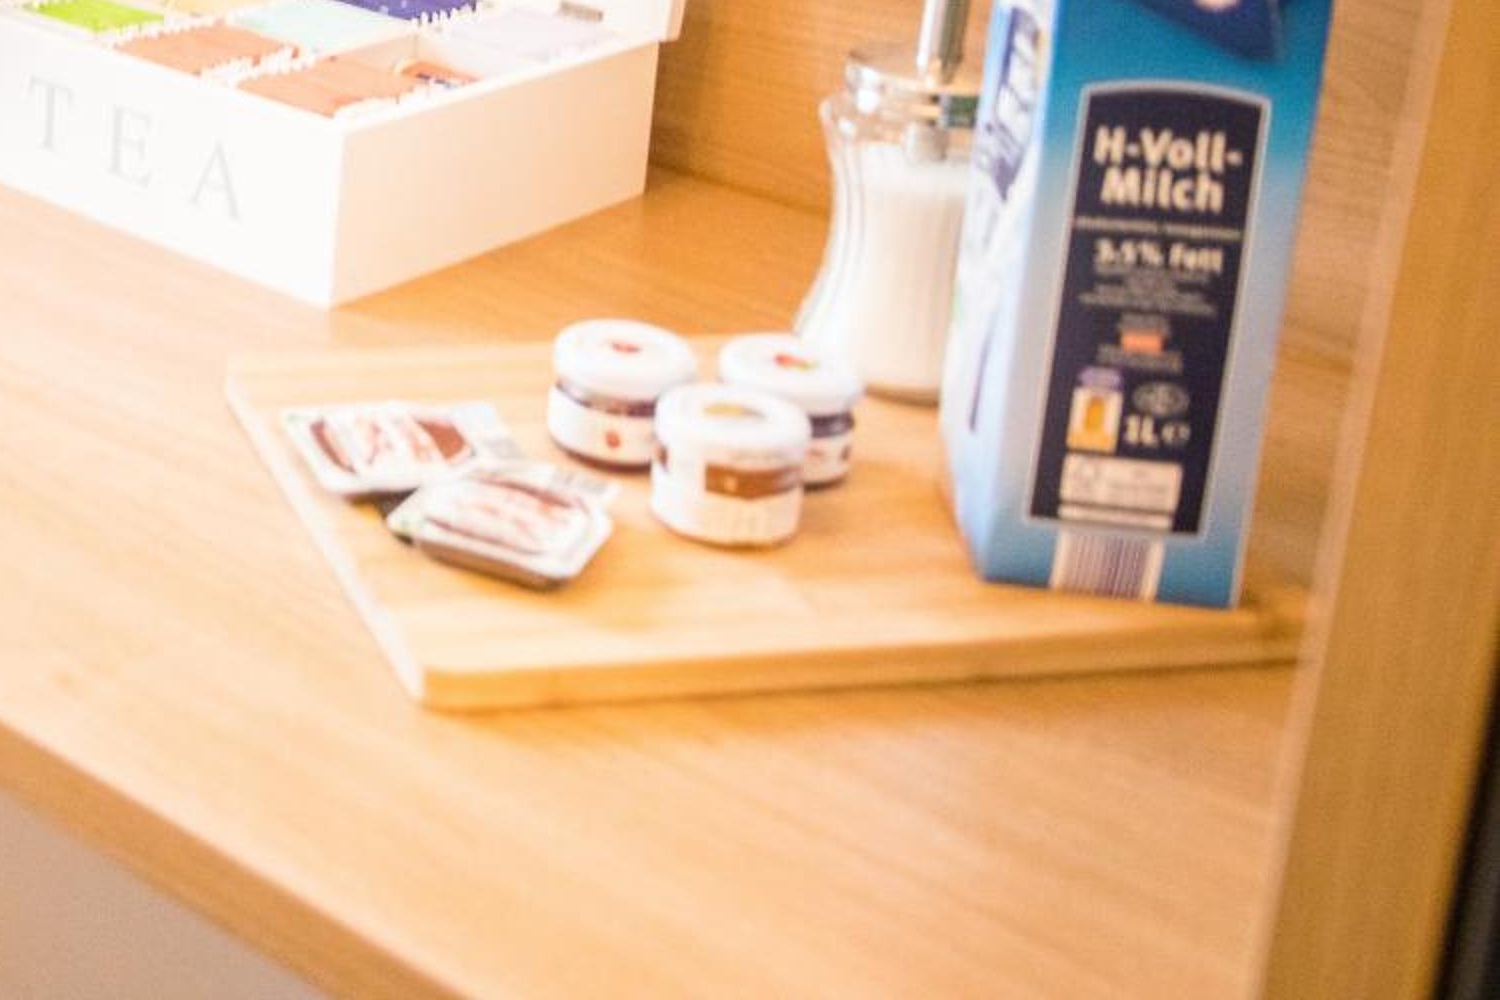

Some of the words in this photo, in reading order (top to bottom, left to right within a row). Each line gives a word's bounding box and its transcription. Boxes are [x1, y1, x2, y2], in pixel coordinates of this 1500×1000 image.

[27, 74, 241, 222] TEA
[1094, 125, 1242, 172] H-Voll-
[1102, 166, 1224, 214] Milch
